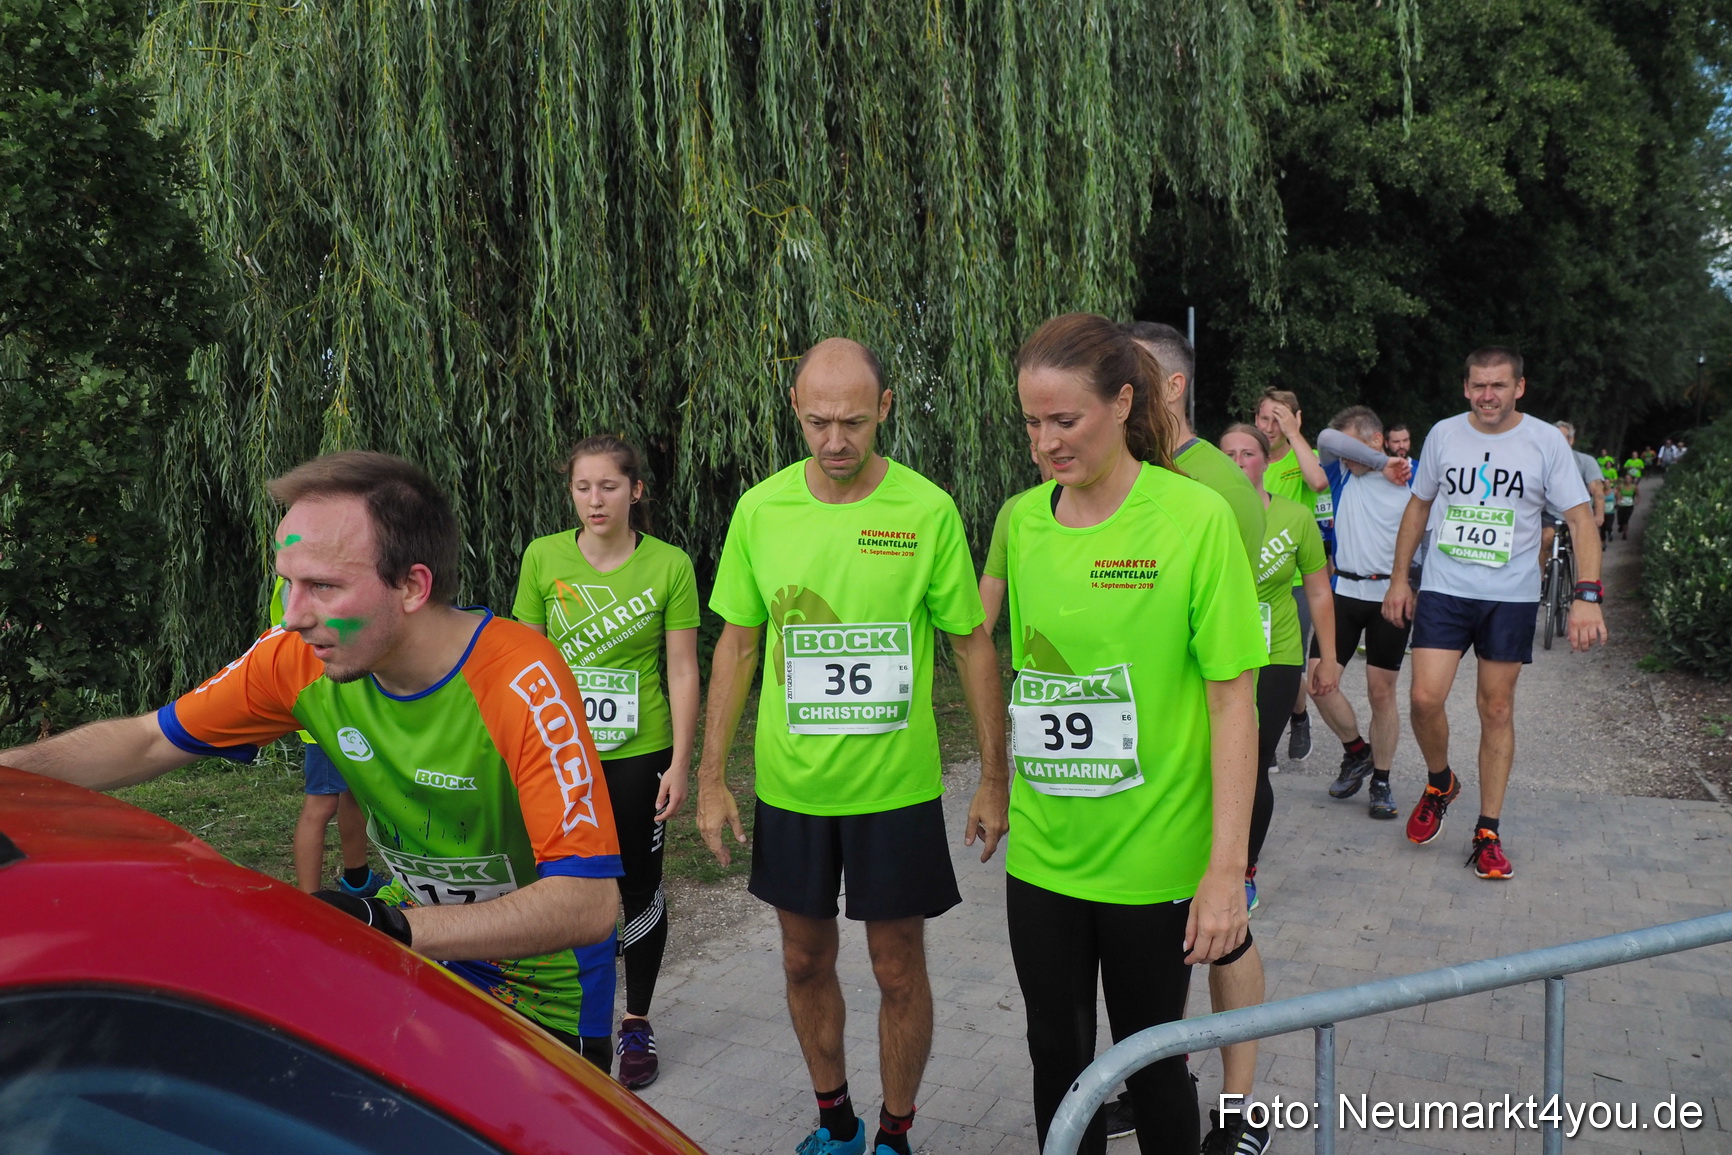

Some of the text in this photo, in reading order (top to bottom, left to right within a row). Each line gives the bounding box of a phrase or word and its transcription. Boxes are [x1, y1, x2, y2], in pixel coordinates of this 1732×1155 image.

[1446, 464, 1524, 499] SUSPA
[1450, 507, 1509, 525] BOCK
[858, 538, 918, 549] ELEMENTELAUF
[861, 530, 916, 539] NEUMARKTER
[1455, 525, 1497, 546] 140
[1259, 528, 1293, 568] RDT
[1449, 547, 1496, 560] JOHANN
[1094, 559, 1157, 568] NEUMARKTER
[1090, 570, 1159, 579] ELEMENTELAUF
[1100, 582, 1137, 590] September
[560, 588, 657, 664] RKHARDT
[793, 628, 900, 654] BOCK
[580, 652, 596, 667] UND
[573, 671, 629, 692] OCK
[825, 663, 872, 695] 36
[798, 705, 899, 720] CHRISTOPH
[590, 730, 627, 740] ISKA
[1040, 712, 1094, 751] 39
[509, 660, 599, 837] BOCK
[1023, 761, 1124, 779] KATHARINA
[415, 769, 478, 790] BOCK
